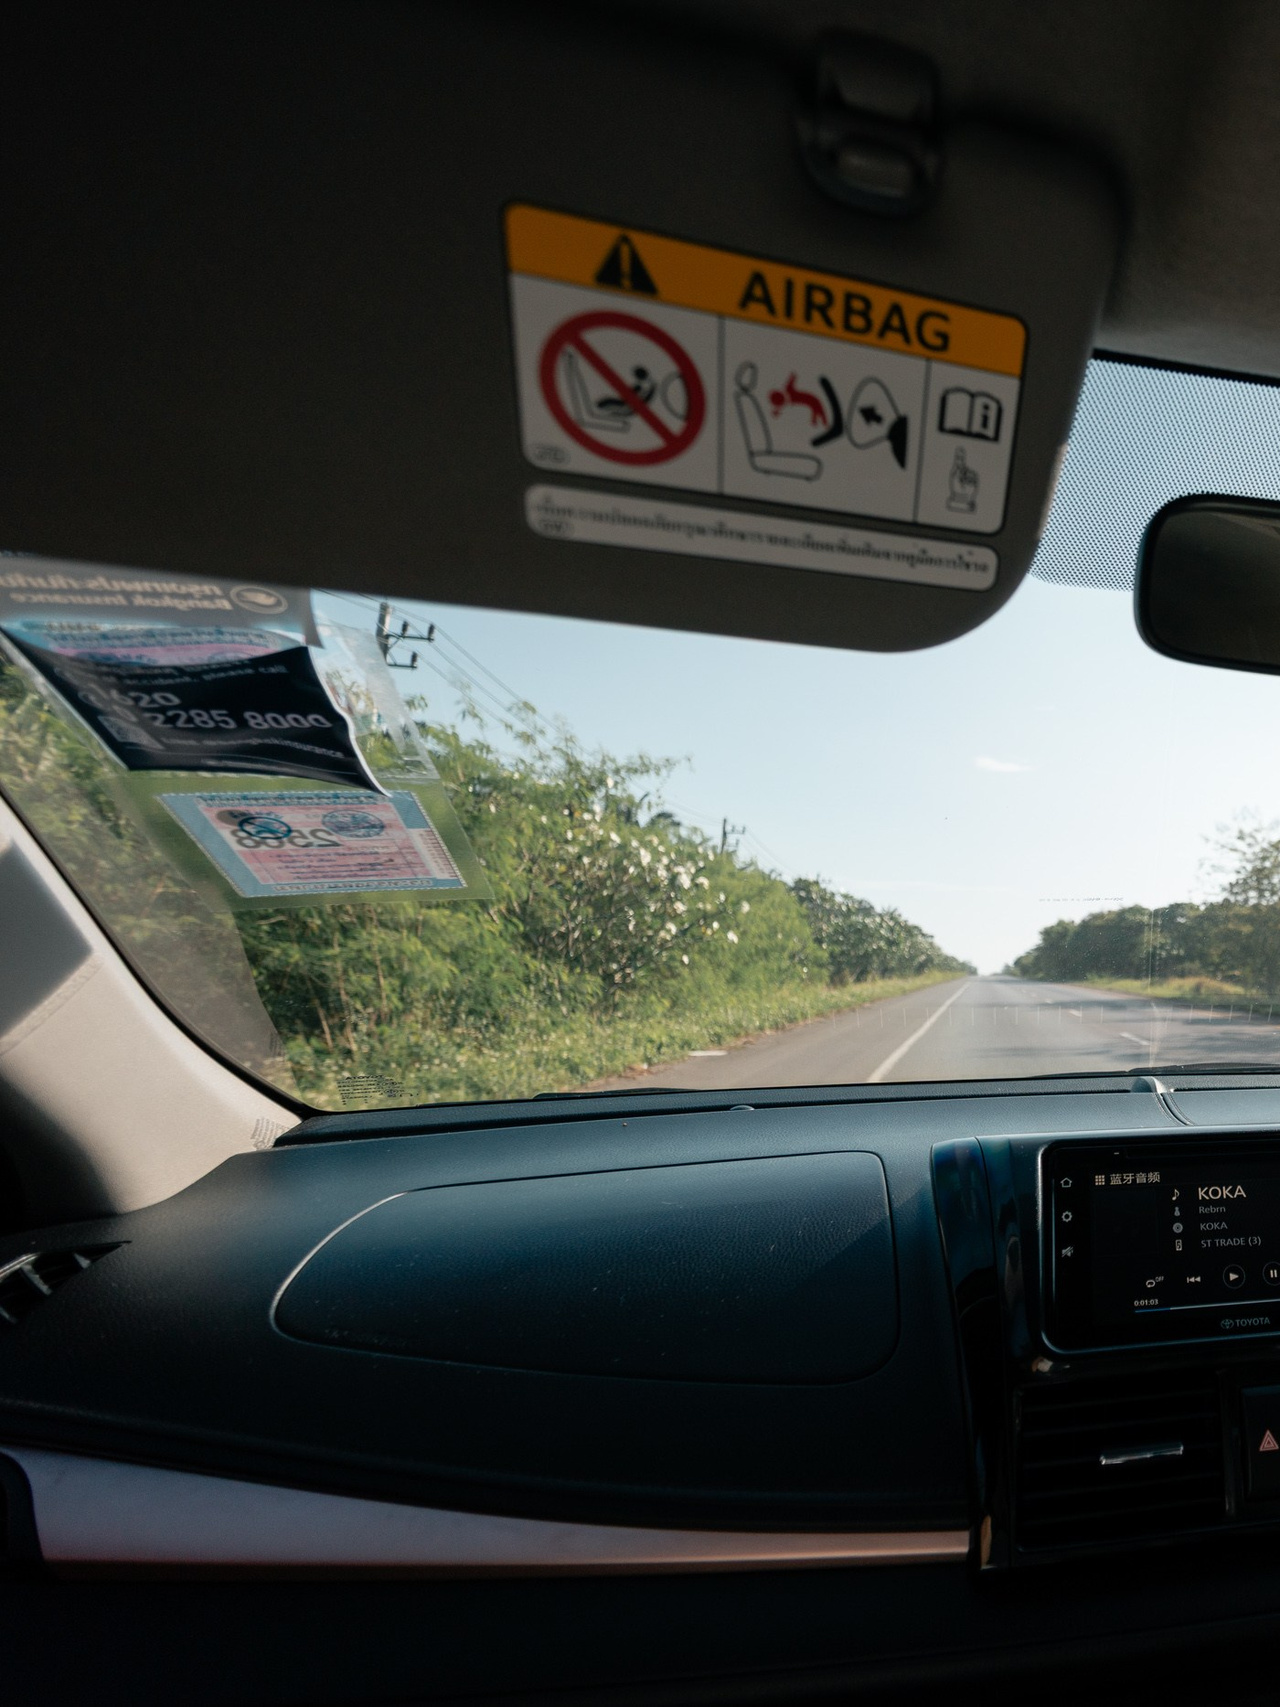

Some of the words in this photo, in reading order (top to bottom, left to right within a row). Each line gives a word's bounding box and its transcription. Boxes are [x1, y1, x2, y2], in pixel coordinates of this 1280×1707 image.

[739, 270, 951, 353] AIRBAG
[243, 711, 333, 729] 8000
[1110, 1172, 1161, 1186] 蓝牙音频
[1198, 1185, 1247, 1201] KOKA
[1199, 1204, 1226, 1214] Rebrn
[1200, 1221, 1228, 1231] KOKA
[1201, 1239, 1213, 1248] ST
[1213, 1237, 1246, 1247] TRADE
[1248, 1236, 1262, 1247] (3)
[1134, 1299, 1159, 1307] 0:01:03
[1235, 1316, 1271, 1327] TOYOTA
